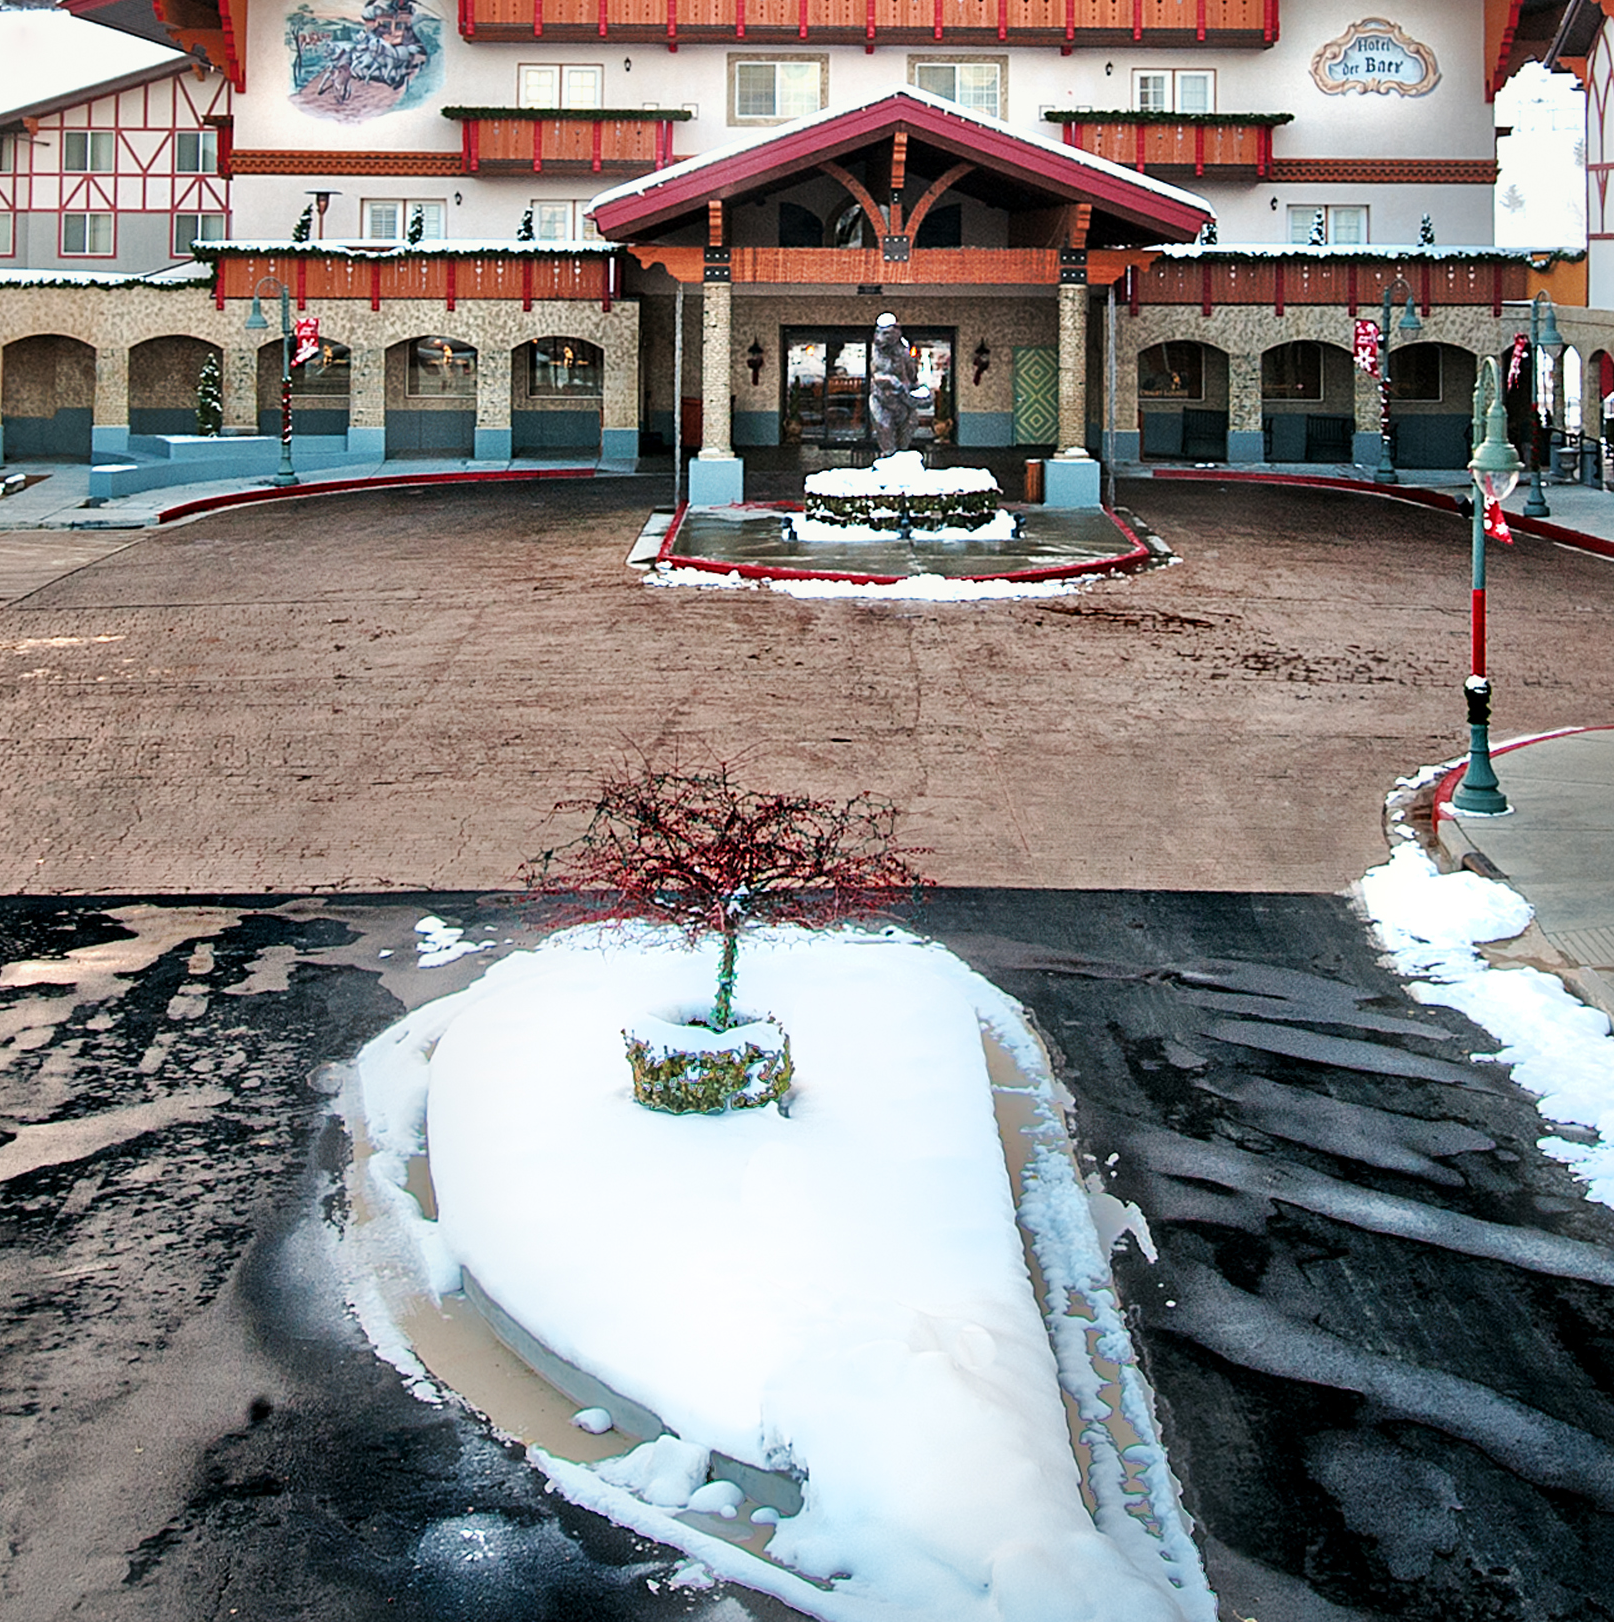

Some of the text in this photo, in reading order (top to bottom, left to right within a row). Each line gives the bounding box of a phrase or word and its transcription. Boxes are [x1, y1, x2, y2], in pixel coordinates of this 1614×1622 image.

[1358, 39, 1391, 52] Hotel
[1343, 57, 1404, 75] der Baer
